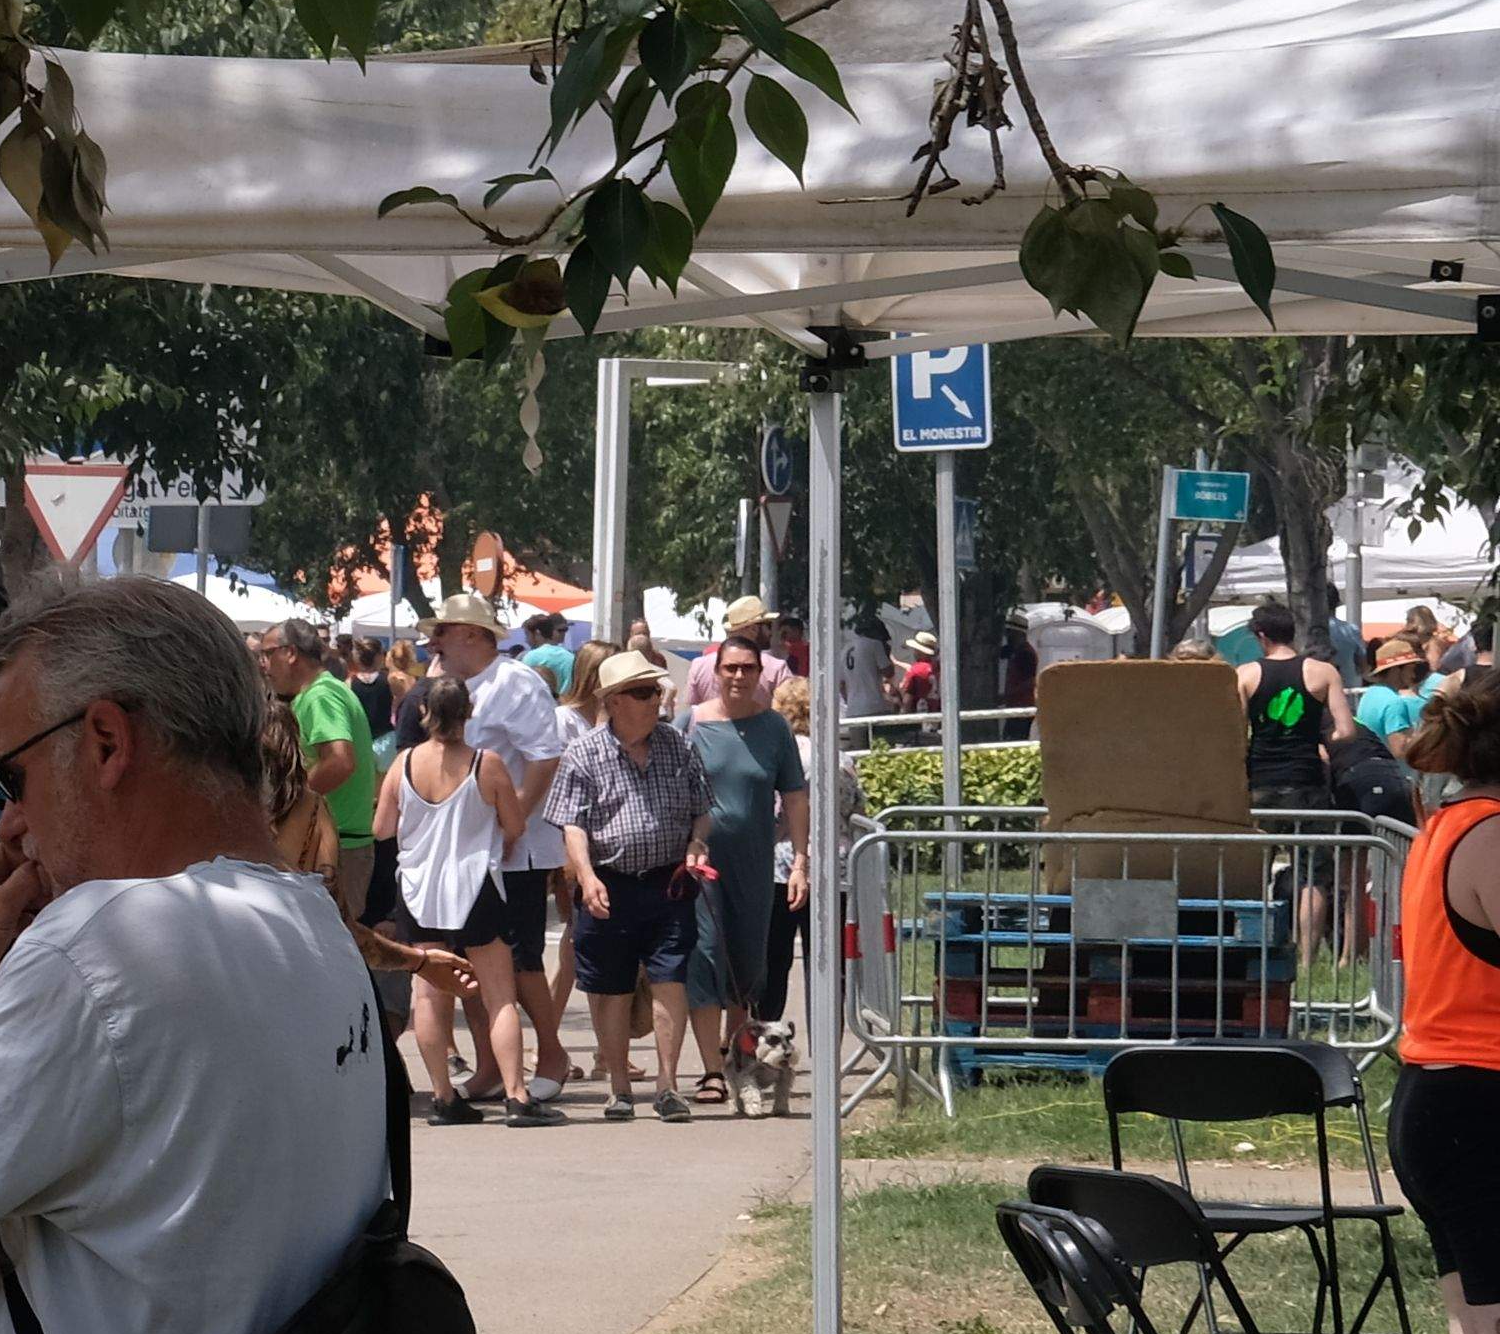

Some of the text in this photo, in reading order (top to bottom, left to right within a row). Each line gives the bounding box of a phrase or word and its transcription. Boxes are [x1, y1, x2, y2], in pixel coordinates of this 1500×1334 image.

[911, 342, 969, 399] P
[902, 427, 982, 441] EL MONESTIR
[846, 647, 854, 670] 6
